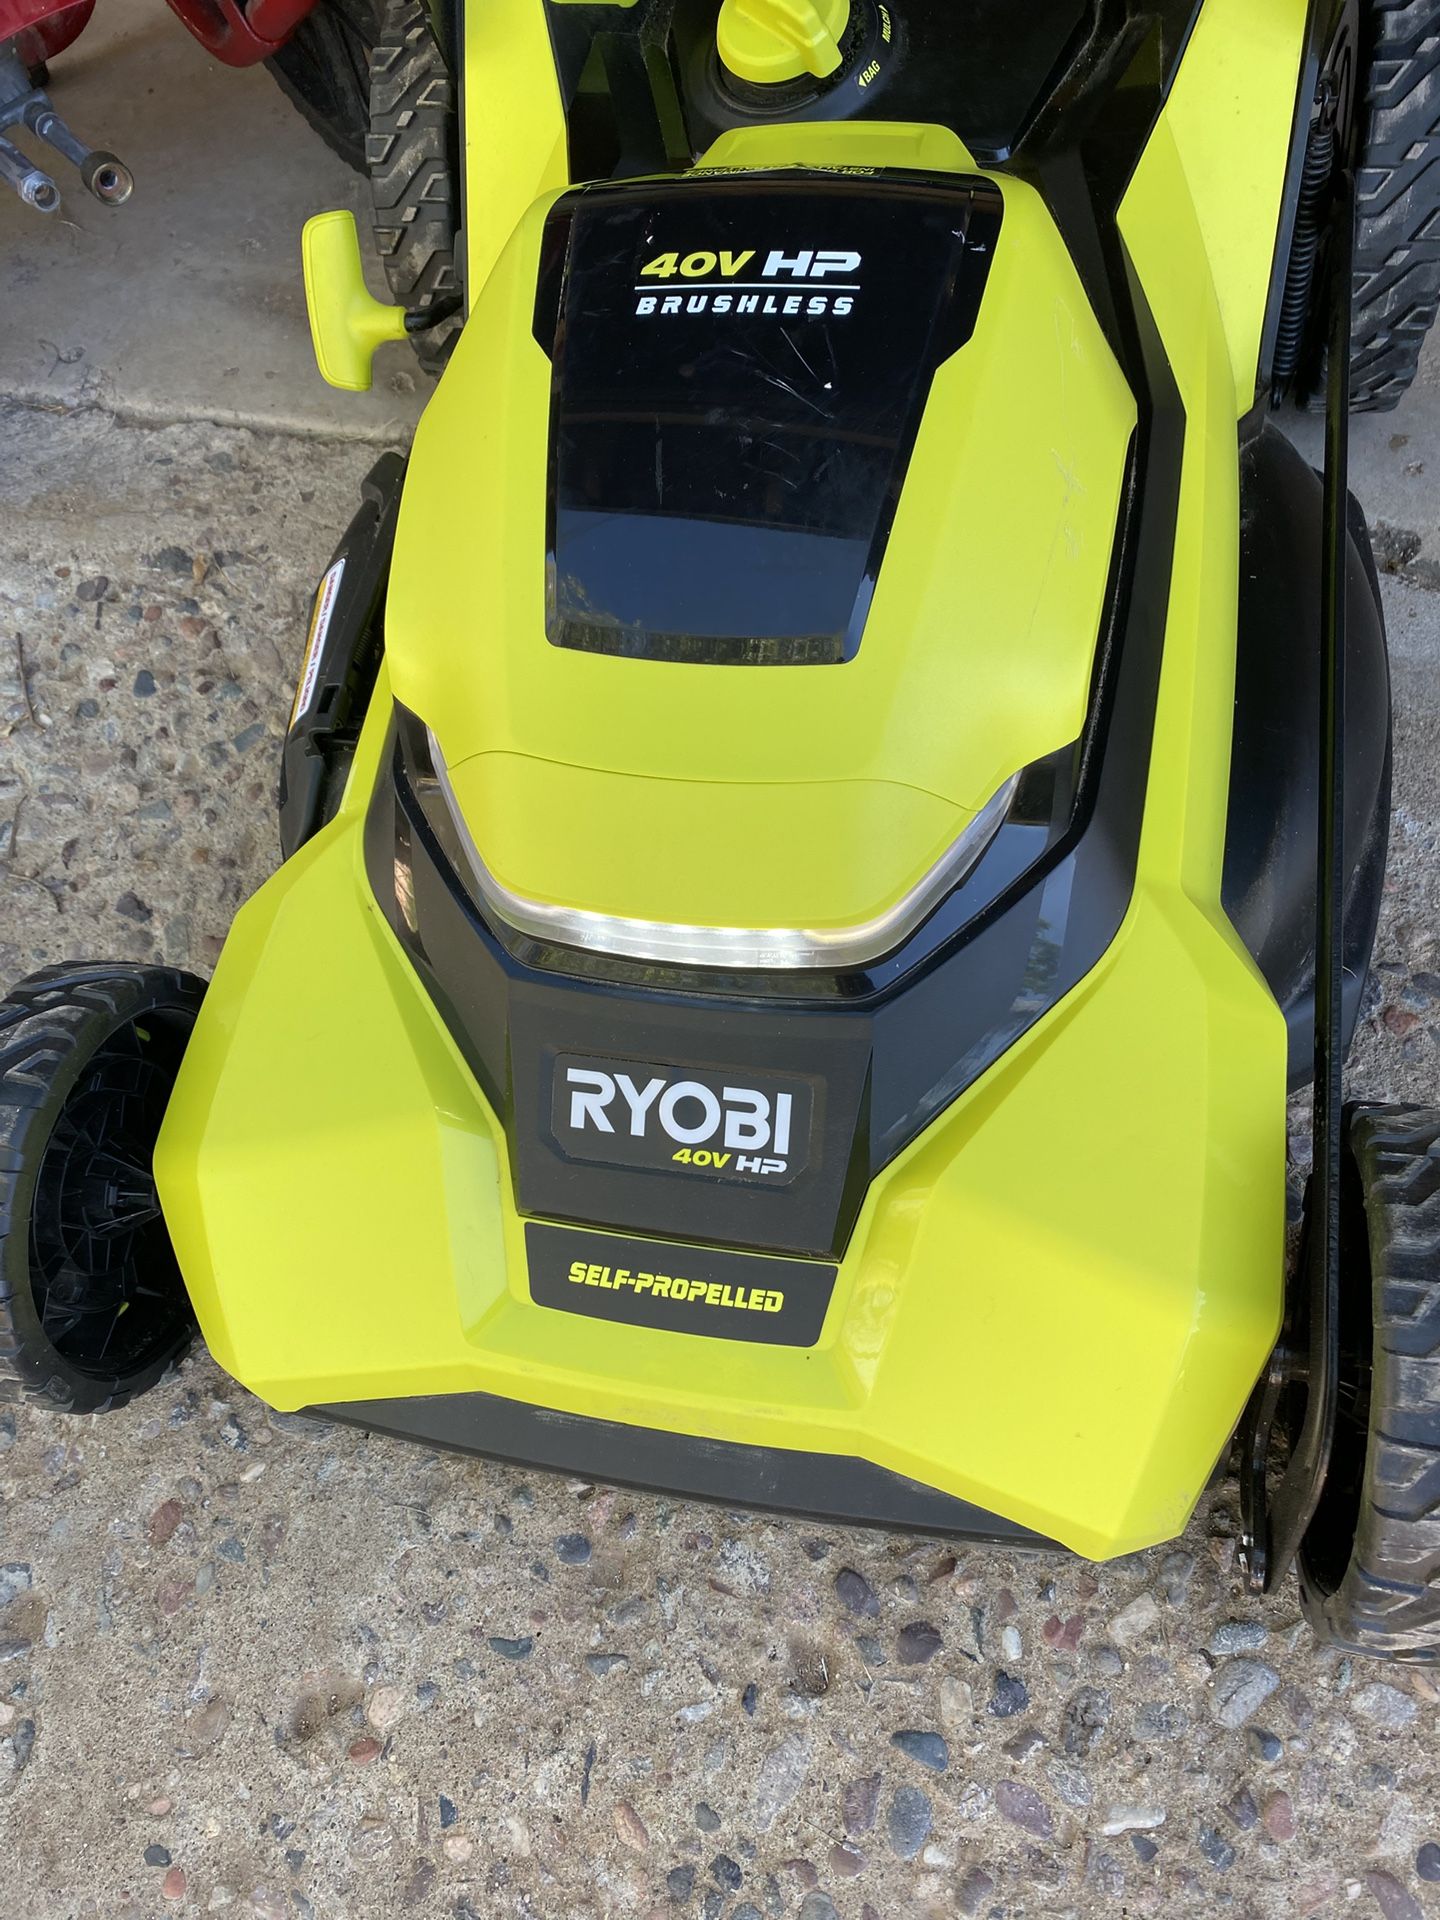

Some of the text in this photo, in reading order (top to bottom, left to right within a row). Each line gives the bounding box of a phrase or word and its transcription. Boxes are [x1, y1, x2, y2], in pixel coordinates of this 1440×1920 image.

[881, 10, 891, 43] MULCH
[863, 60, 880, 83] BAG
[640, 250, 862, 278] 40V HP
[635, 295, 854, 315] BRUSHLESS
[566, 1067, 793, 1156] RYOBI
[672, 1148, 788, 1175] 40V HP
[568, 1261, 785, 1314] SELF-PROPELLED
